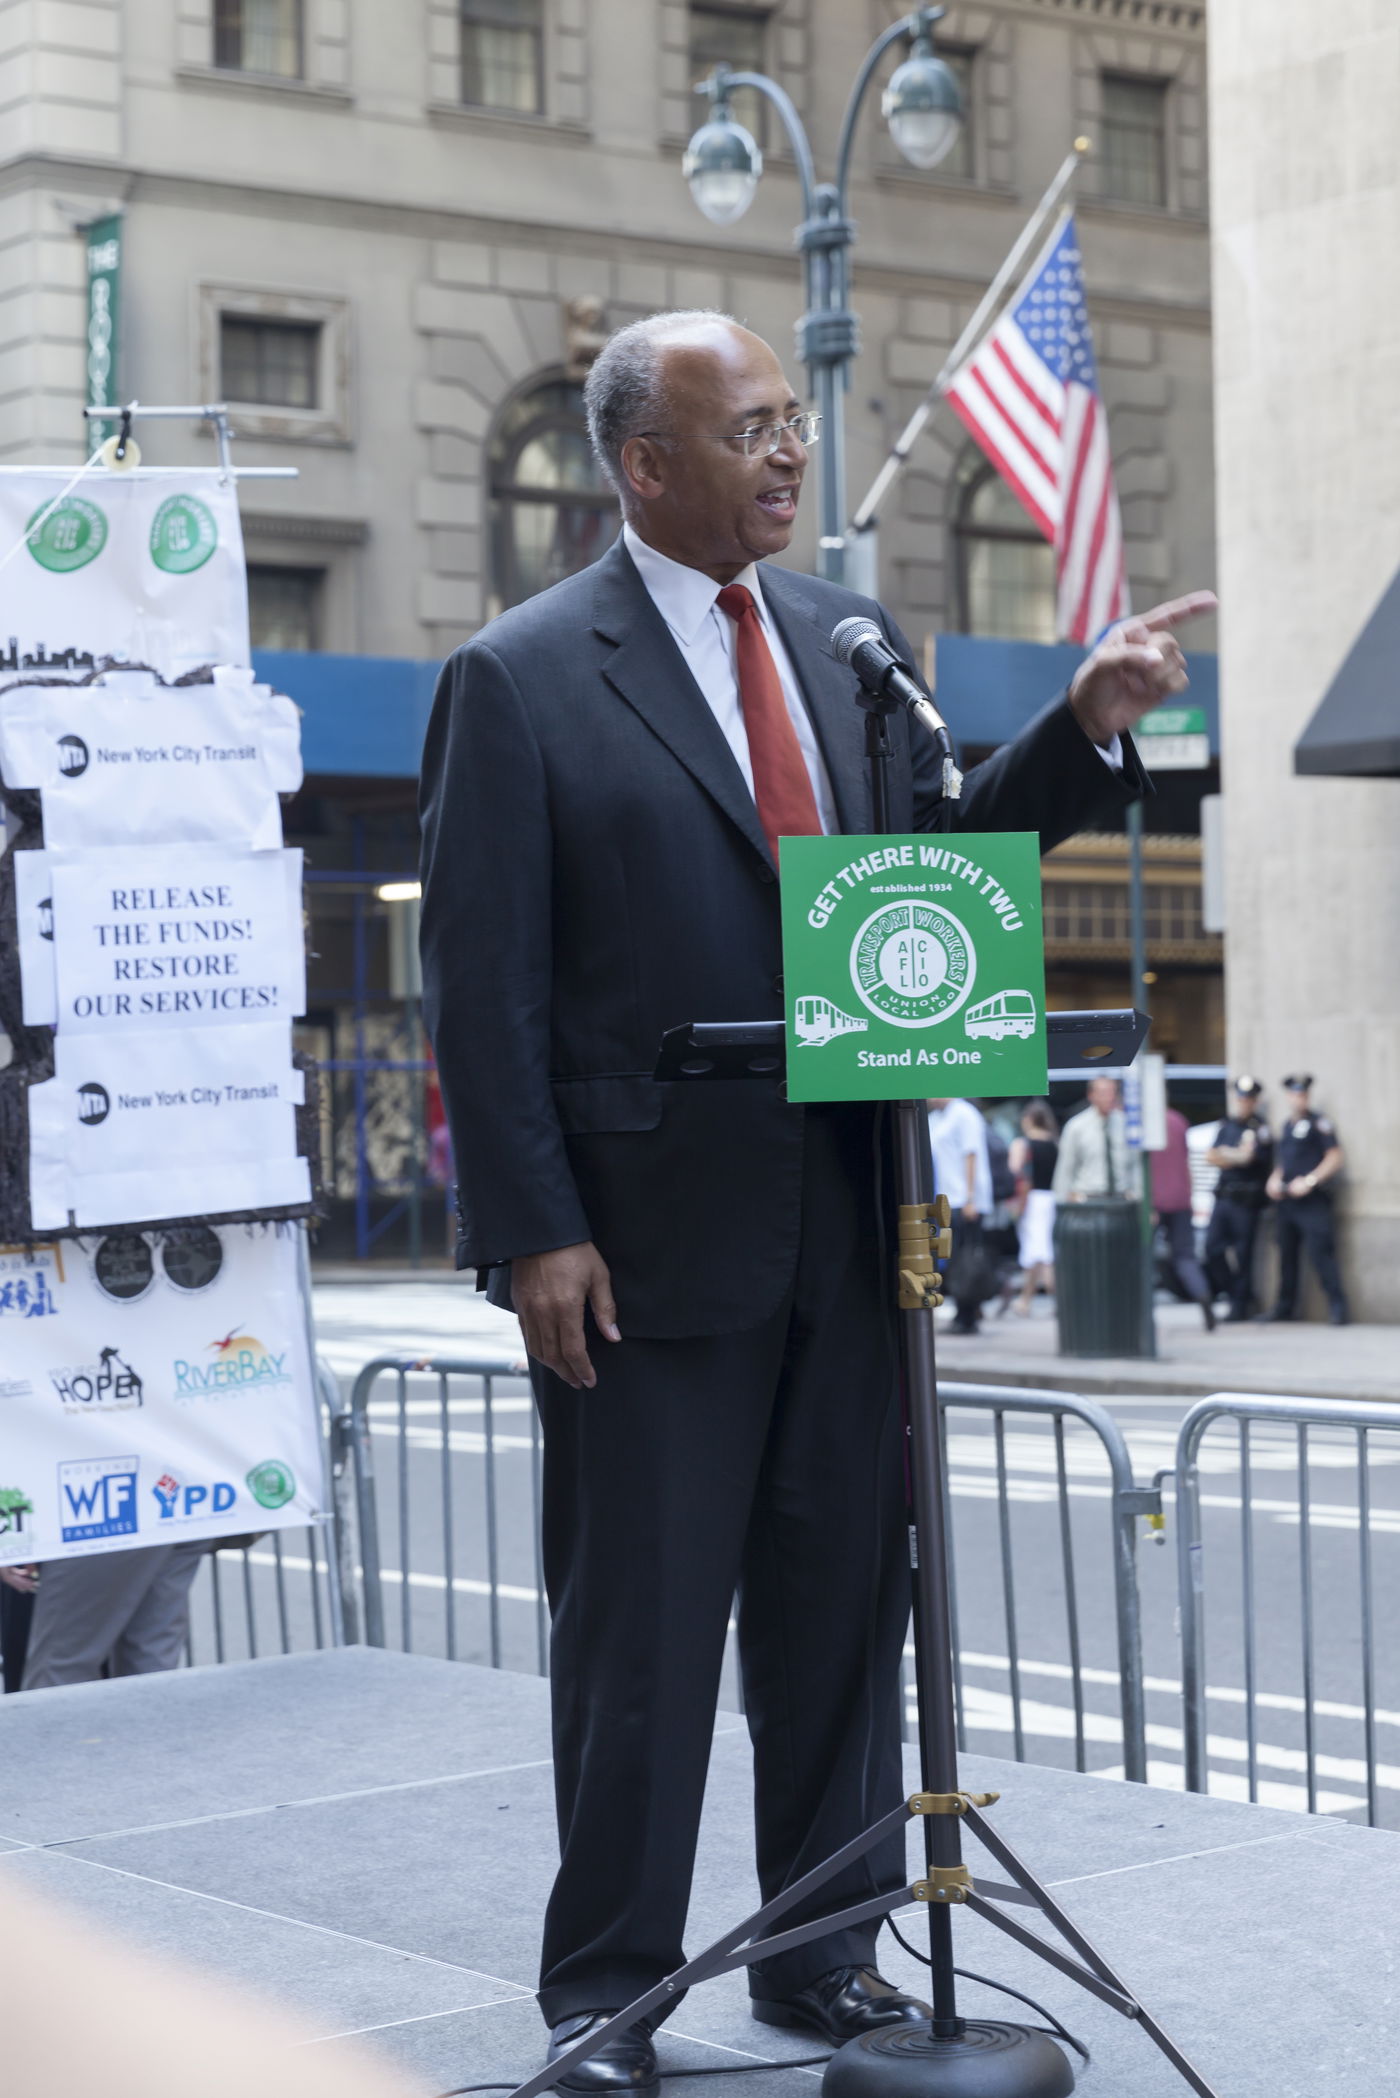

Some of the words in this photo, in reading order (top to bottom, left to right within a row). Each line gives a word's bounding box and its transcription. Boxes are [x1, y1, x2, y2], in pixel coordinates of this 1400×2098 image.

[97, 747, 132, 763] New
[135, 747, 169, 762] York
[172, 744, 201, 765] City
[204, 744, 257, 761] Transit
[111, 885, 233, 911] RELEASE
[807, 880, 844, 929] GET
[836, 845, 915, 888] THERE
[919, 845, 983, 886] WITH
[979, 875, 1024, 932] TWU
[869, 883, 926, 893] established
[928, 883, 953, 892] 1934
[93, 922, 151, 948] THE
[158, 919, 253, 944] FUNDS!
[915, 908, 966, 982] WORKERS
[859, 908, 909, 988] TRANSPORT
[113, 953, 239, 981] RESTORE
[73, 993, 132, 1018] OUR
[139, 986, 278, 1013] SERVICES!
[873, 994, 920, 1016] LOCAL
[928, 991, 956, 1013] 100
[889, 995, 940, 1008] UNION
[857, 1049, 912, 1067] Stand
[916, 1048, 939, 1066] As
[942, 1047, 982, 1064] One
[118, 1093, 152, 1109] New
[155, 1090, 188, 1106] York
[190, 1087, 222, 1106] City
[225, 1083, 279, 1101] Transit
[51, 1374, 134, 1403] HOPE
